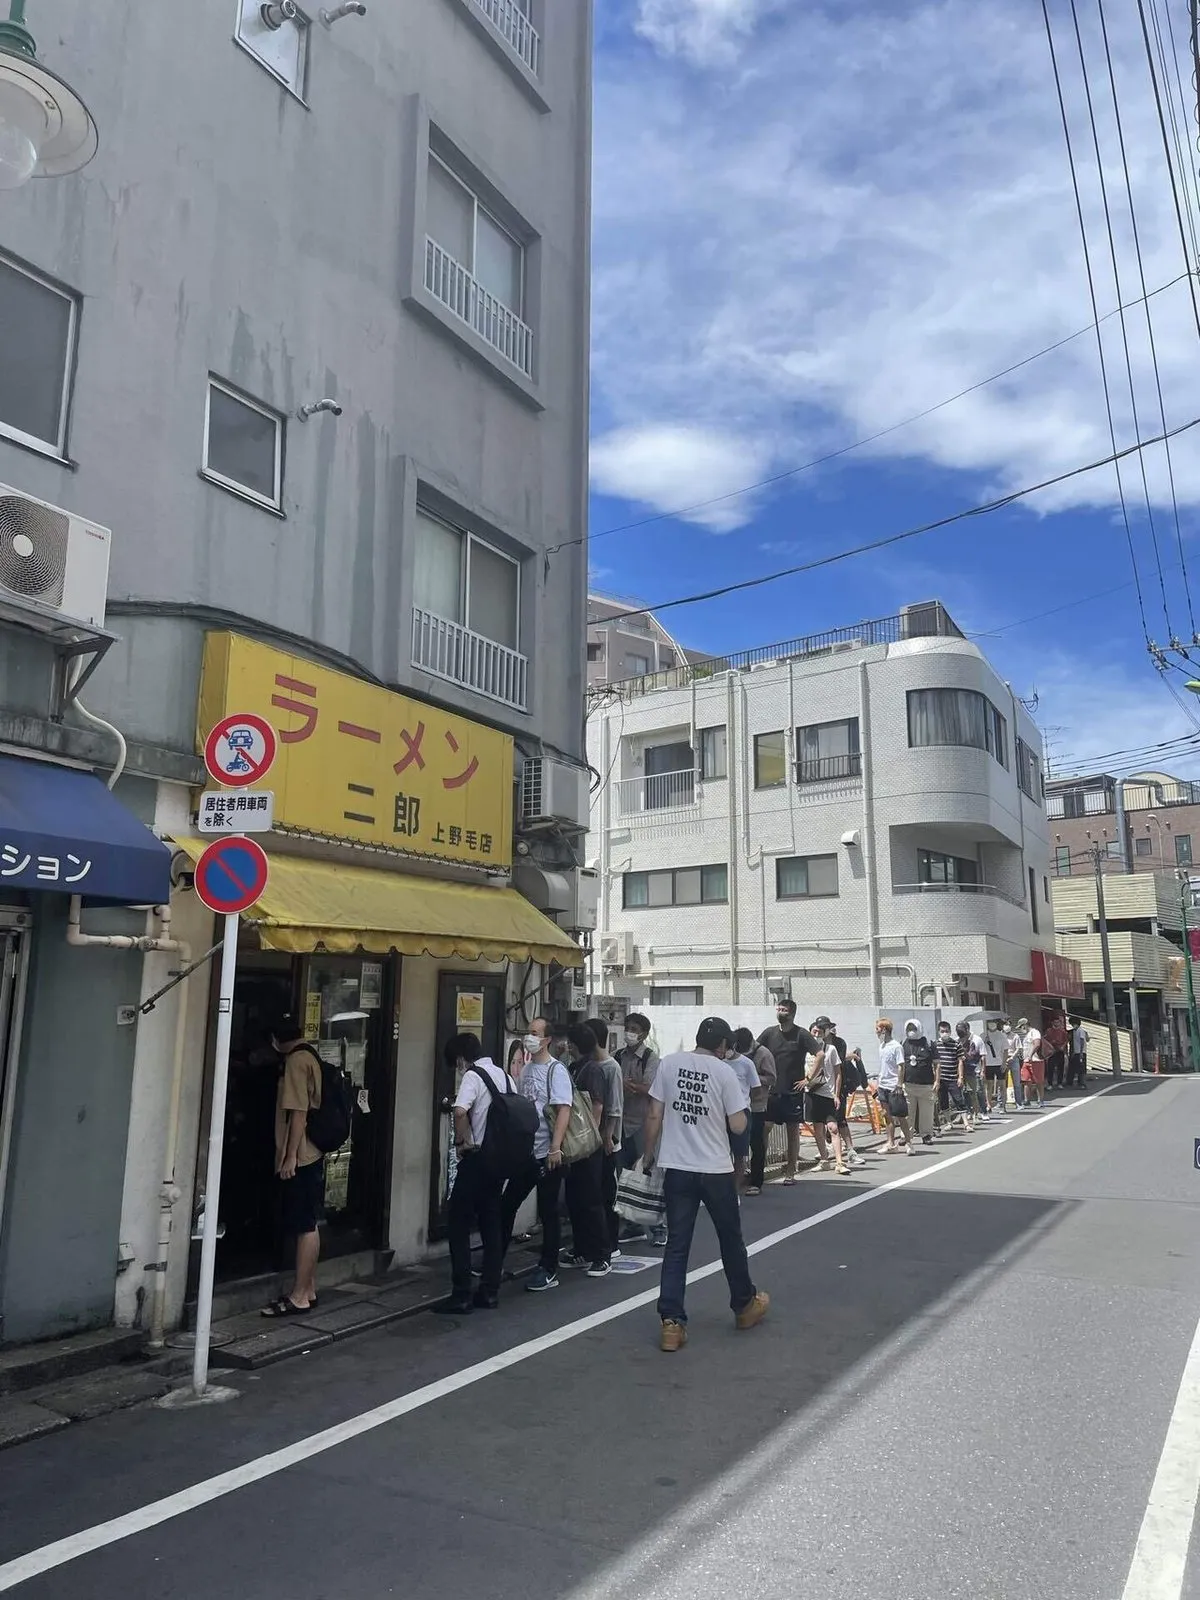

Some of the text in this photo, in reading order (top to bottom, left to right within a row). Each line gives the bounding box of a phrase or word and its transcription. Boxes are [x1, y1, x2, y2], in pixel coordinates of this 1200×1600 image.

[271, 673, 480, 790] ラーメン
[205, 796, 268, 812] 居住者用車両
[204, 812, 233, 827] を除く
[343, 783, 493, 854] 二郎 上野毛店
[1, 844, 92, 882] ション
[678, 1068, 709, 1082] KEEP
[677, 1079, 708, 1094] COOL
[679, 1091, 703, 1104] AND
[672, 1101, 709, 1116] CARRY
[682, 1114, 698, 1126] ON
